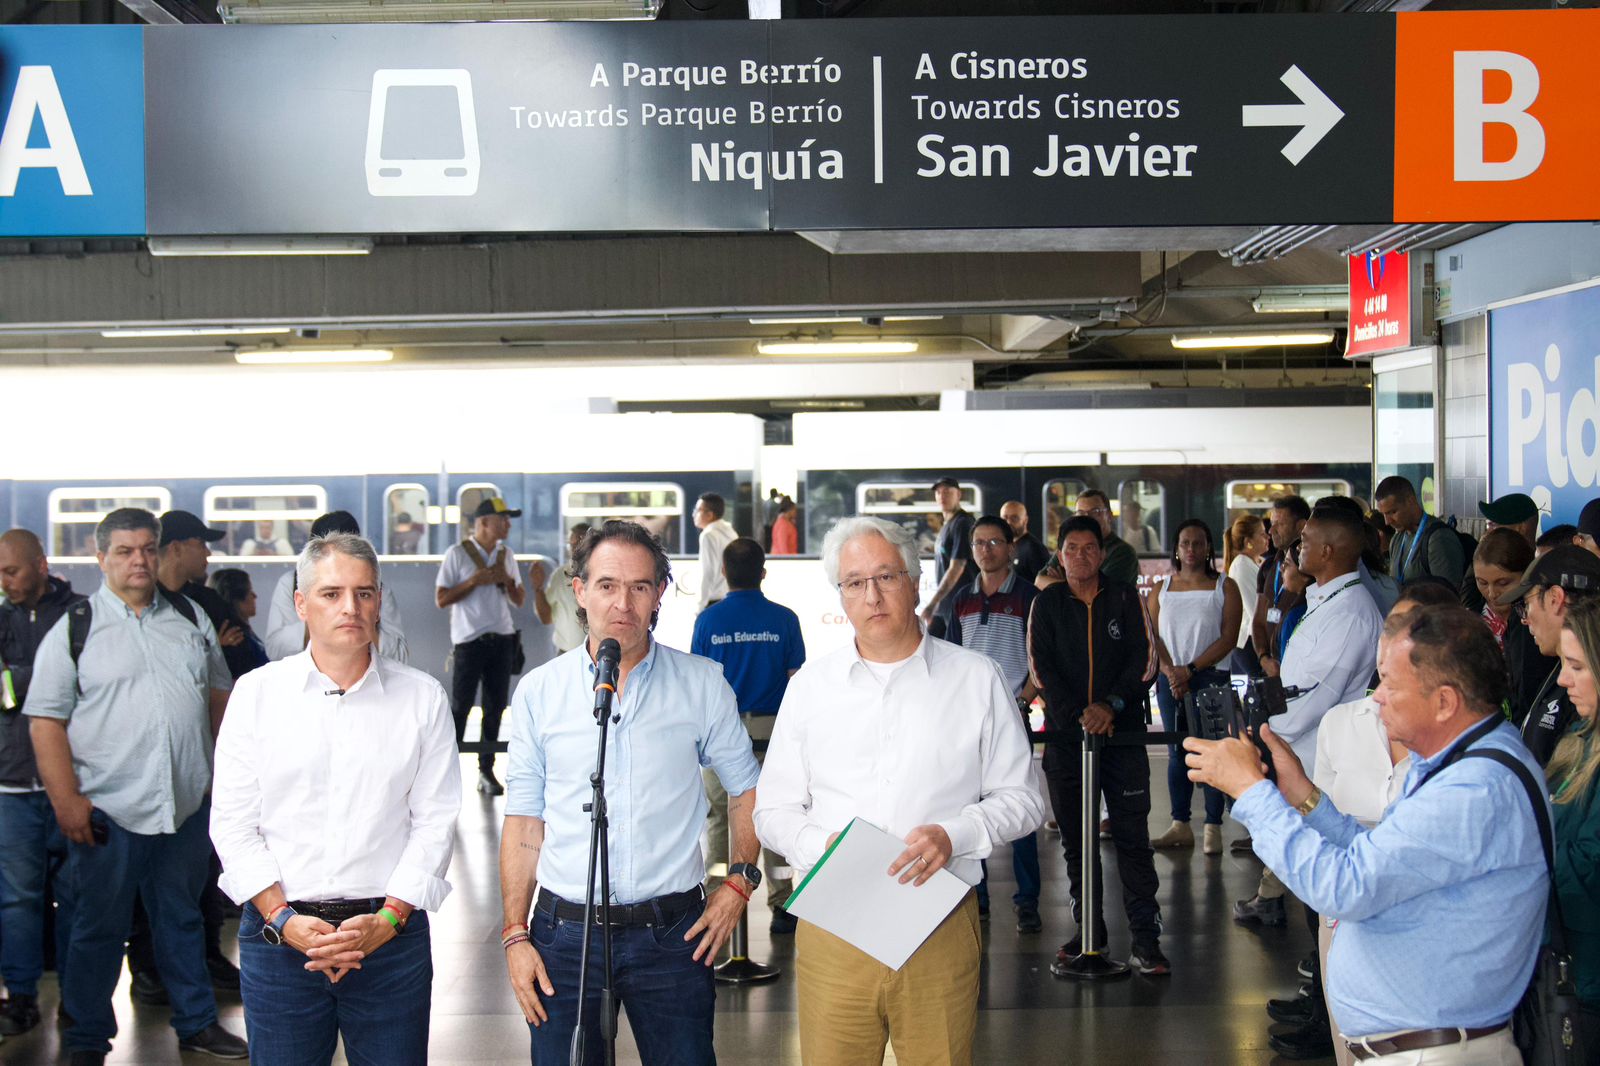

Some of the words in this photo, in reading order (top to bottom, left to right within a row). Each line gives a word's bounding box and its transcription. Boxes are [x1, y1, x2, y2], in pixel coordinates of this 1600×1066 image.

[590, 63, 610, 88] A
[622, 62, 727, 91] Parque
[740, 57, 841, 84] Berrío
[915, 53, 937, 80] A
[950, 51, 1088, 80] Cisneros
[510, 104, 629, 129] Towards
[641, 103, 738, 130] Parque
[750, 98, 843, 124] Berrío
[911, 94, 1041, 120] Towards
[1054, 93, 1181, 119] Cisneros
[1453, 50, 1546, 182] B
[0, 65, 93, 196] A
[691, 138, 844, 190] Niquía
[916, 134, 1010, 178] San
[1032, 132, 1198, 178] Javier
[1354, 321, 1378, 343] Domicilios
[1384, 318, 1398, 336] horas
[734, 630, 780, 643] Educativo
